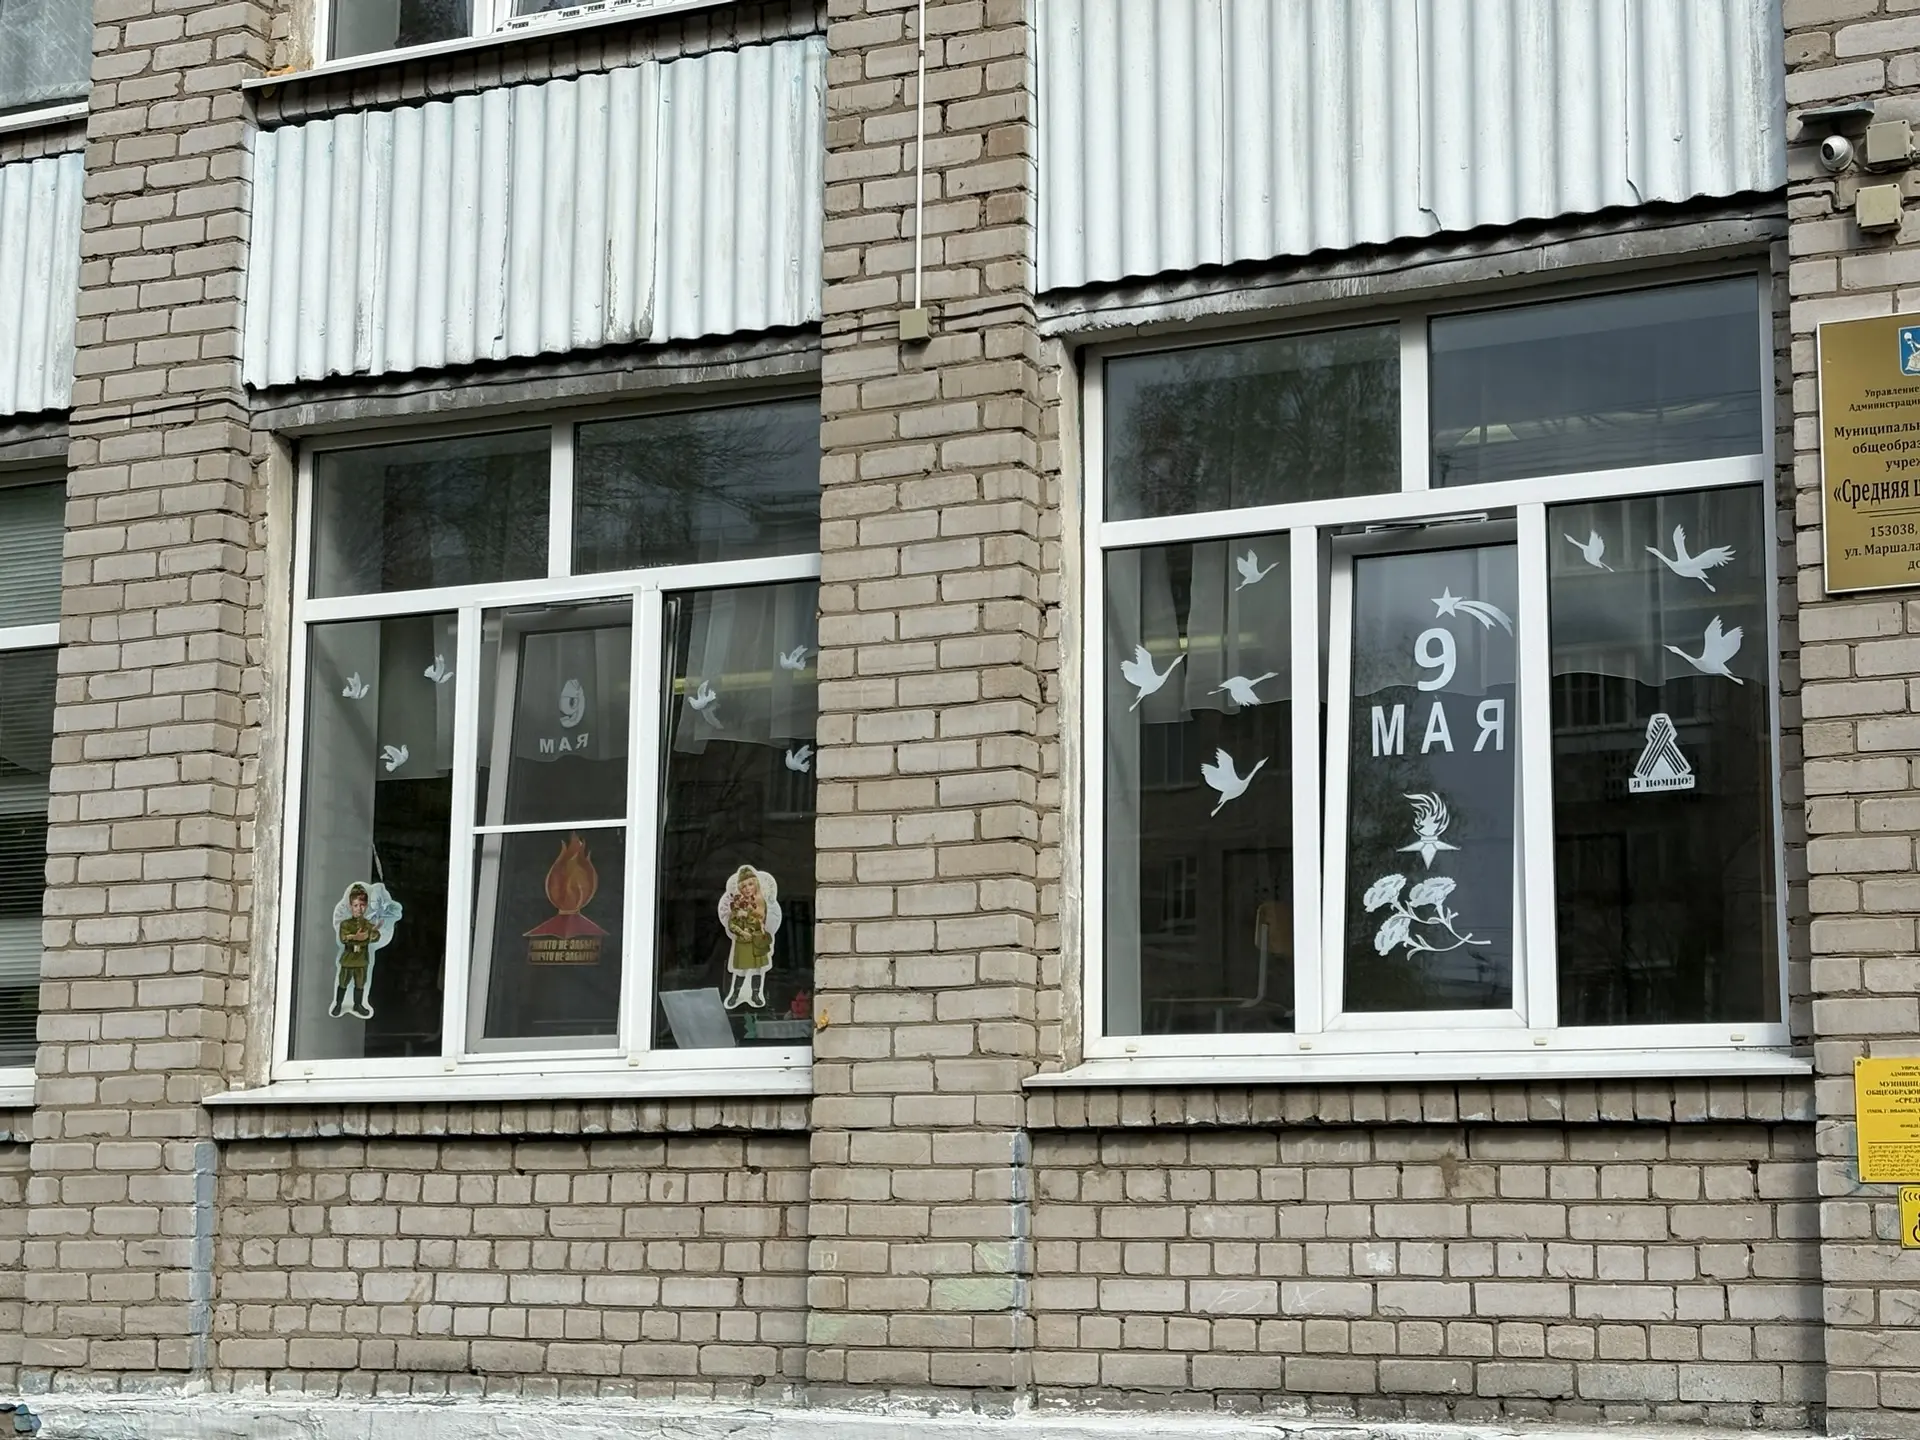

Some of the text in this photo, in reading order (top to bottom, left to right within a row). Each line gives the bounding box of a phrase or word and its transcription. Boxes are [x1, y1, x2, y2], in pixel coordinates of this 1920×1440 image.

[1865, 386, 1920, 399] Управление
[1833, 479, 1909, 509] «Средняя
[1871, 523, 1918, 538] 153038,
[1844, 542, 1920, 560] ул. Маршала
[1414, 627, 1457, 692] 9
[559, 679, 586, 728] 9
[1371, 699, 1505, 757] МАЯ
[540, 733, 589, 754] МАЯ
[1633, 780, 1641, 789] Я
